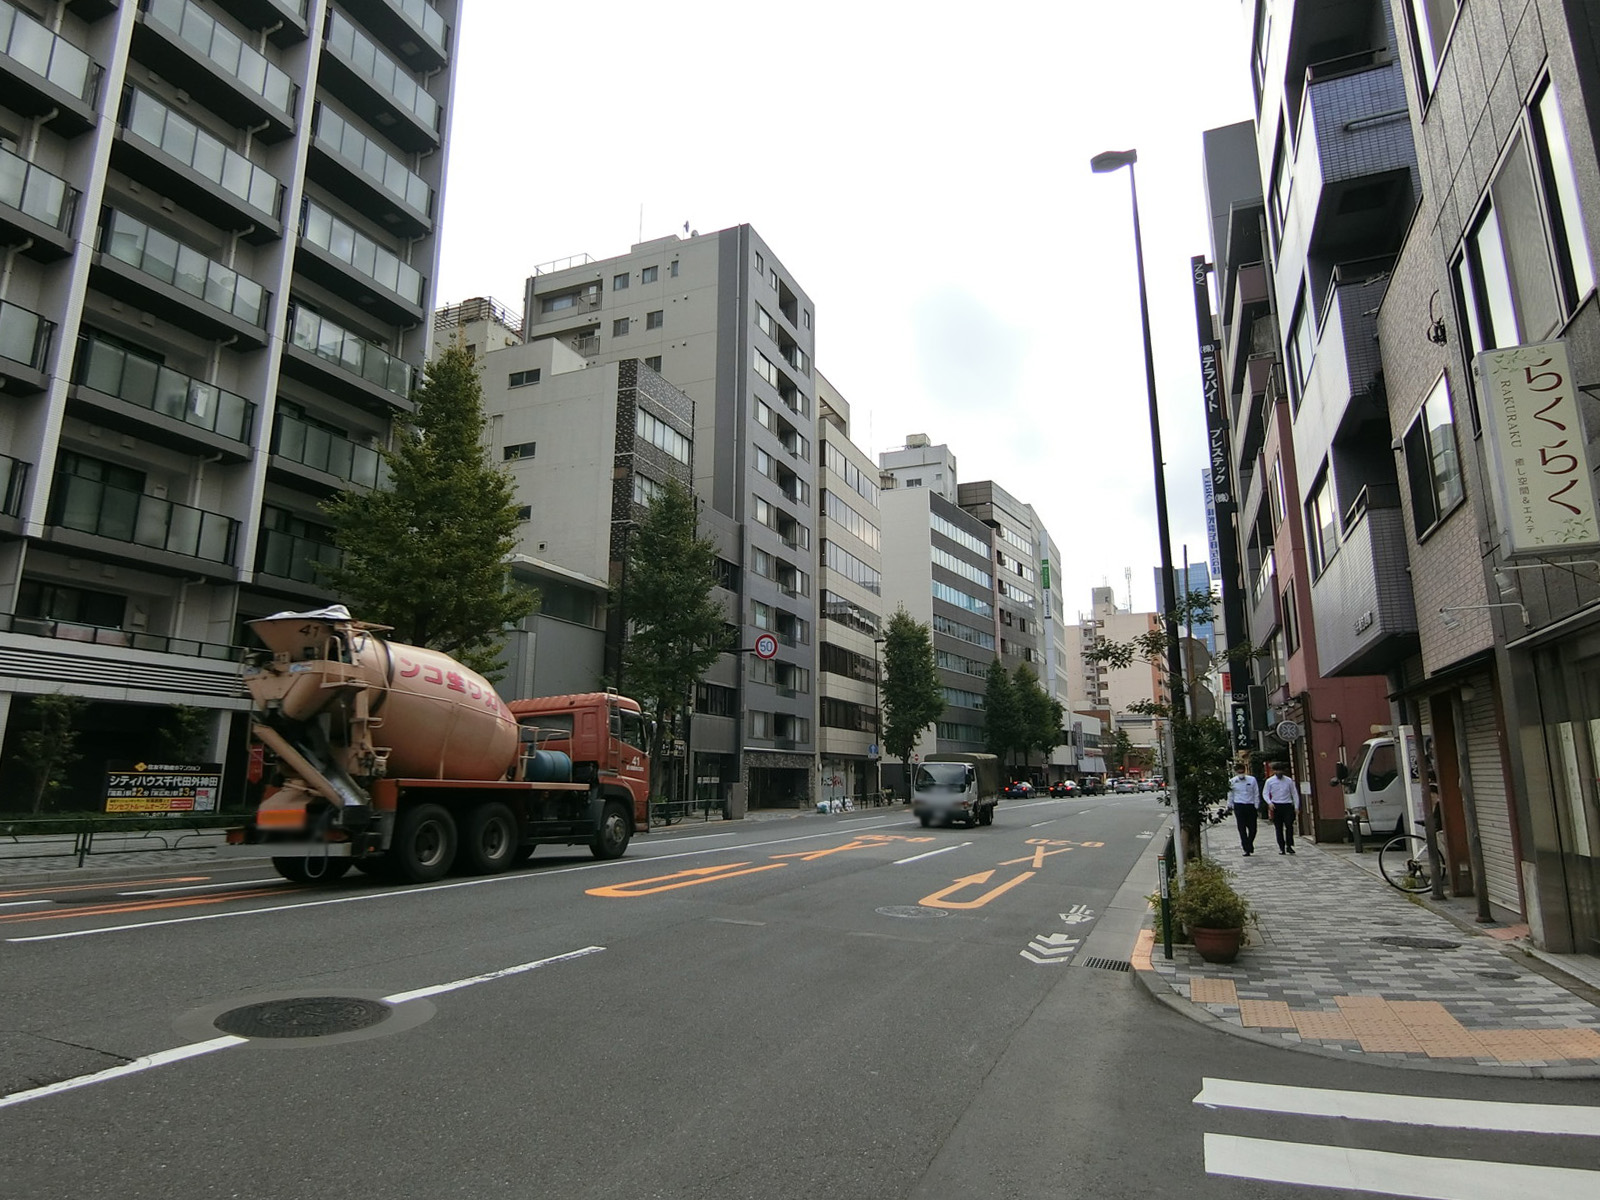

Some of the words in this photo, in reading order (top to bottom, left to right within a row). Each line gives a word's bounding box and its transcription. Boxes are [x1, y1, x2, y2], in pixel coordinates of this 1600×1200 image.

[1500, 379, 1522, 448] RAKURAKU
[1523, 358, 1581, 515] らくらく
[299, 624, 320, 638] 41
[760, 641, 773, 652] 50
[631, 756, 640, 766] 41
[109, 775, 218, 787] シティハウス千代田外神田
